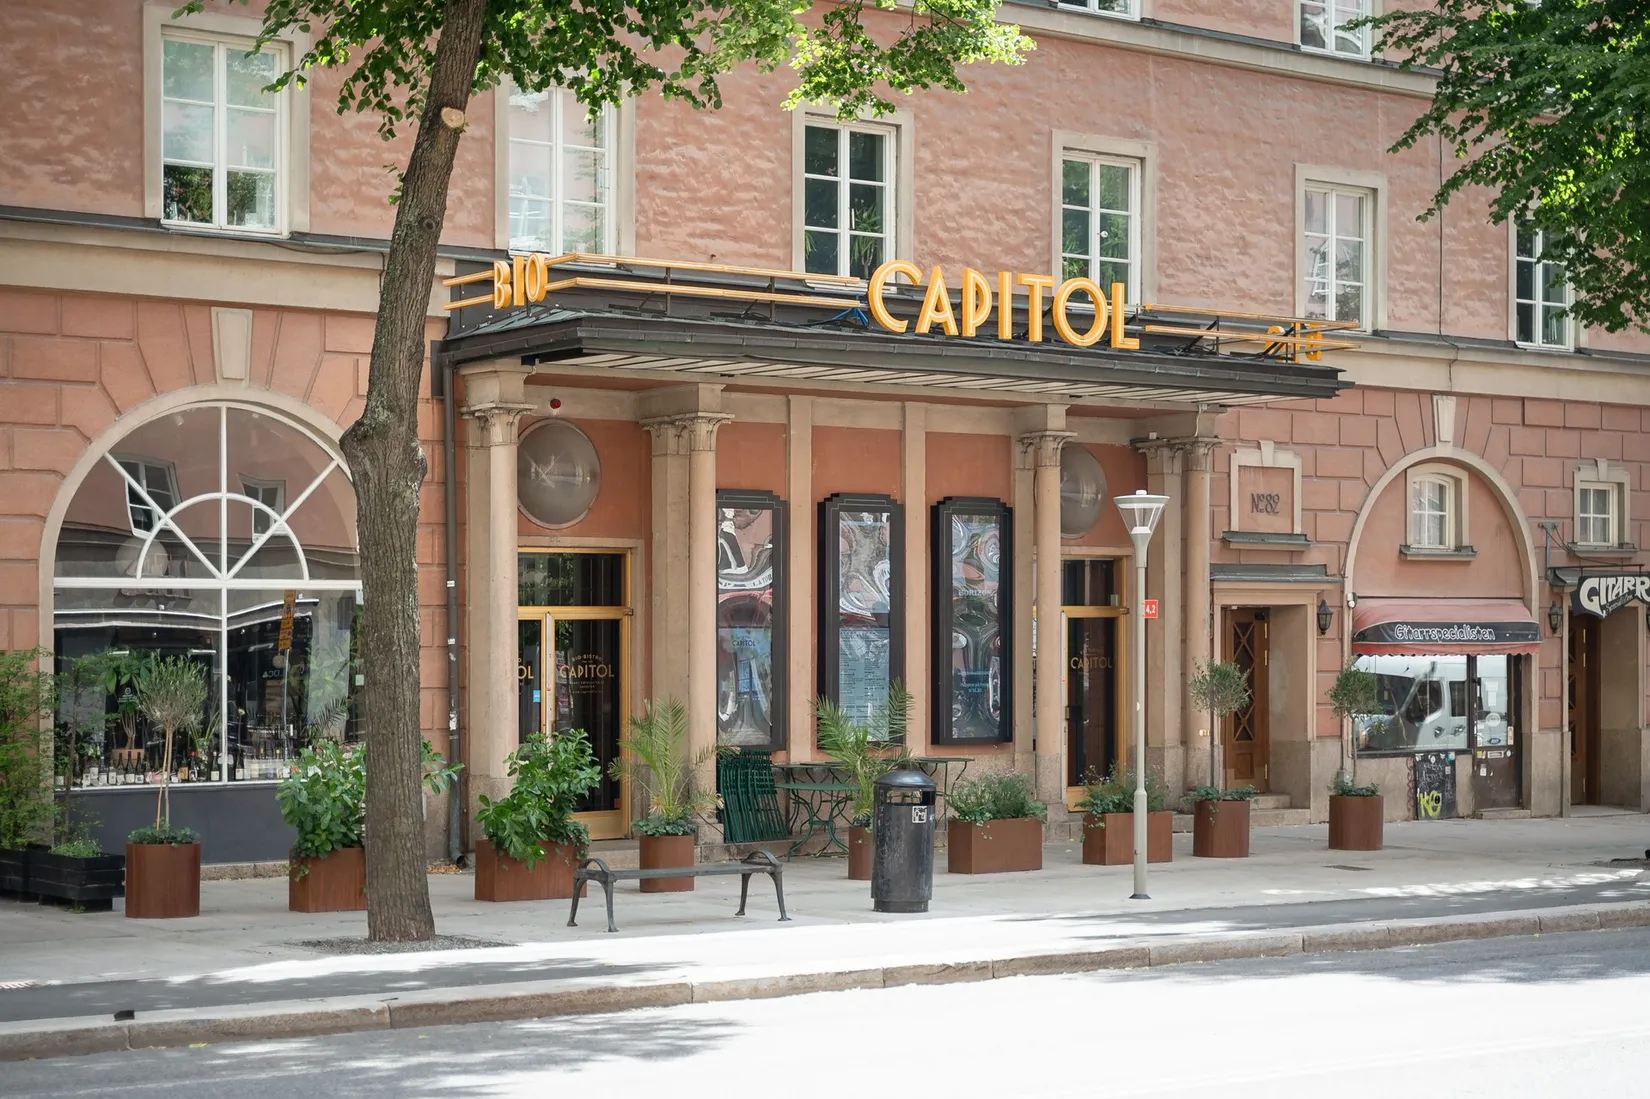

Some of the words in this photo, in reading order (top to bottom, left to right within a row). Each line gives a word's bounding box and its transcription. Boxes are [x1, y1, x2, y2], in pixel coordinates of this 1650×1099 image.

[494, 252, 548, 309] BIO
[868, 259, 1140, 349] CAPITOL
[1145, 604, 1156, 615] 4,2
[1394, 623, 1496, 643] Gitarrspecialisten
[560, 664, 615, 679] CAPITOL
[1070, 656, 1113, 670] CAPITOL
